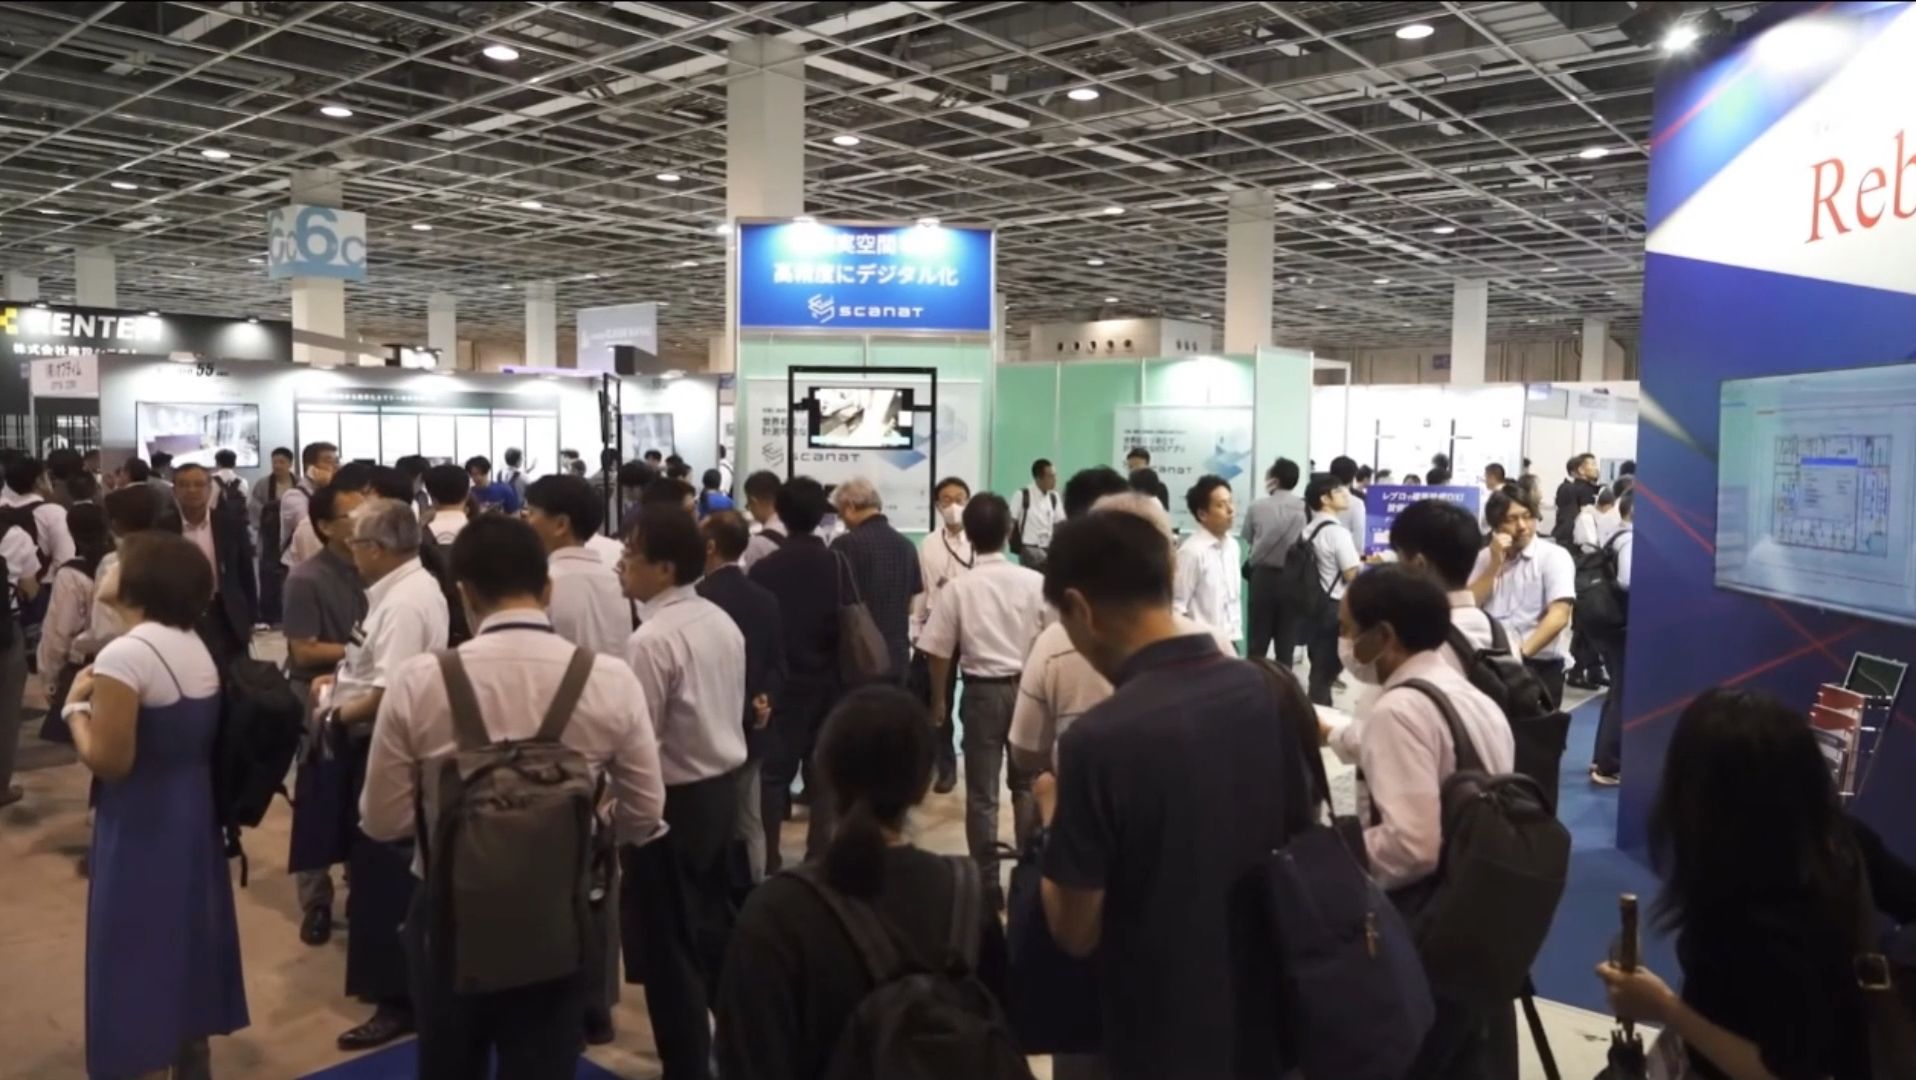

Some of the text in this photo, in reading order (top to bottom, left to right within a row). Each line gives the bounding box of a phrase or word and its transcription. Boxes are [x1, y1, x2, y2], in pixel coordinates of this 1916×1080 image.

[773, 262, 960, 287] 高精度にデジタル化
